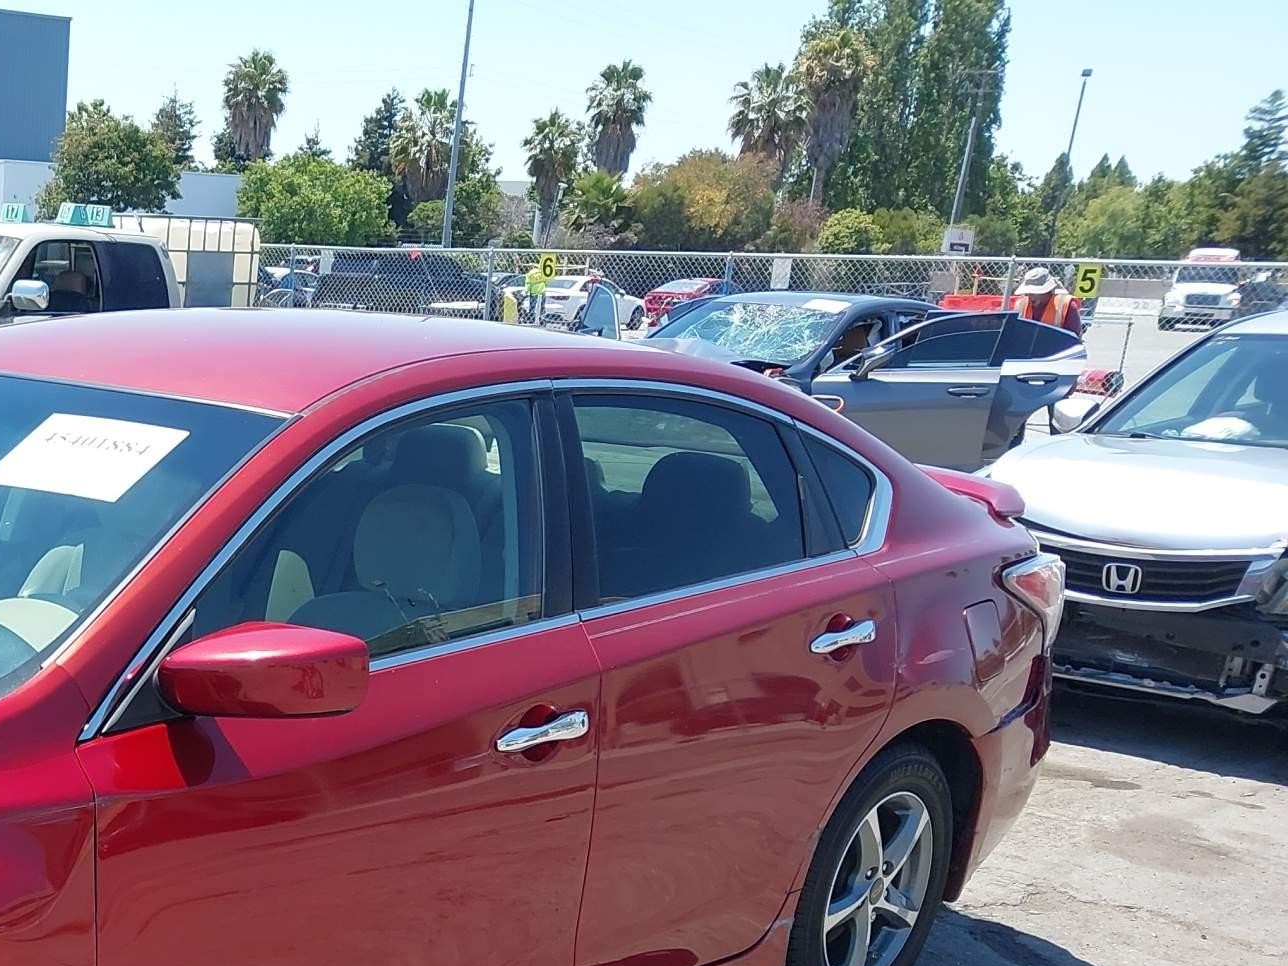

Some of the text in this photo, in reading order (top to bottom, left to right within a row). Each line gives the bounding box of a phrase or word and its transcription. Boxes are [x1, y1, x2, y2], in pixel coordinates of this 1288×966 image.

[91, 206, 104, 220] 13
[542, 257, 553, 277] 6
[1079, 269, 1097, 293] 5
